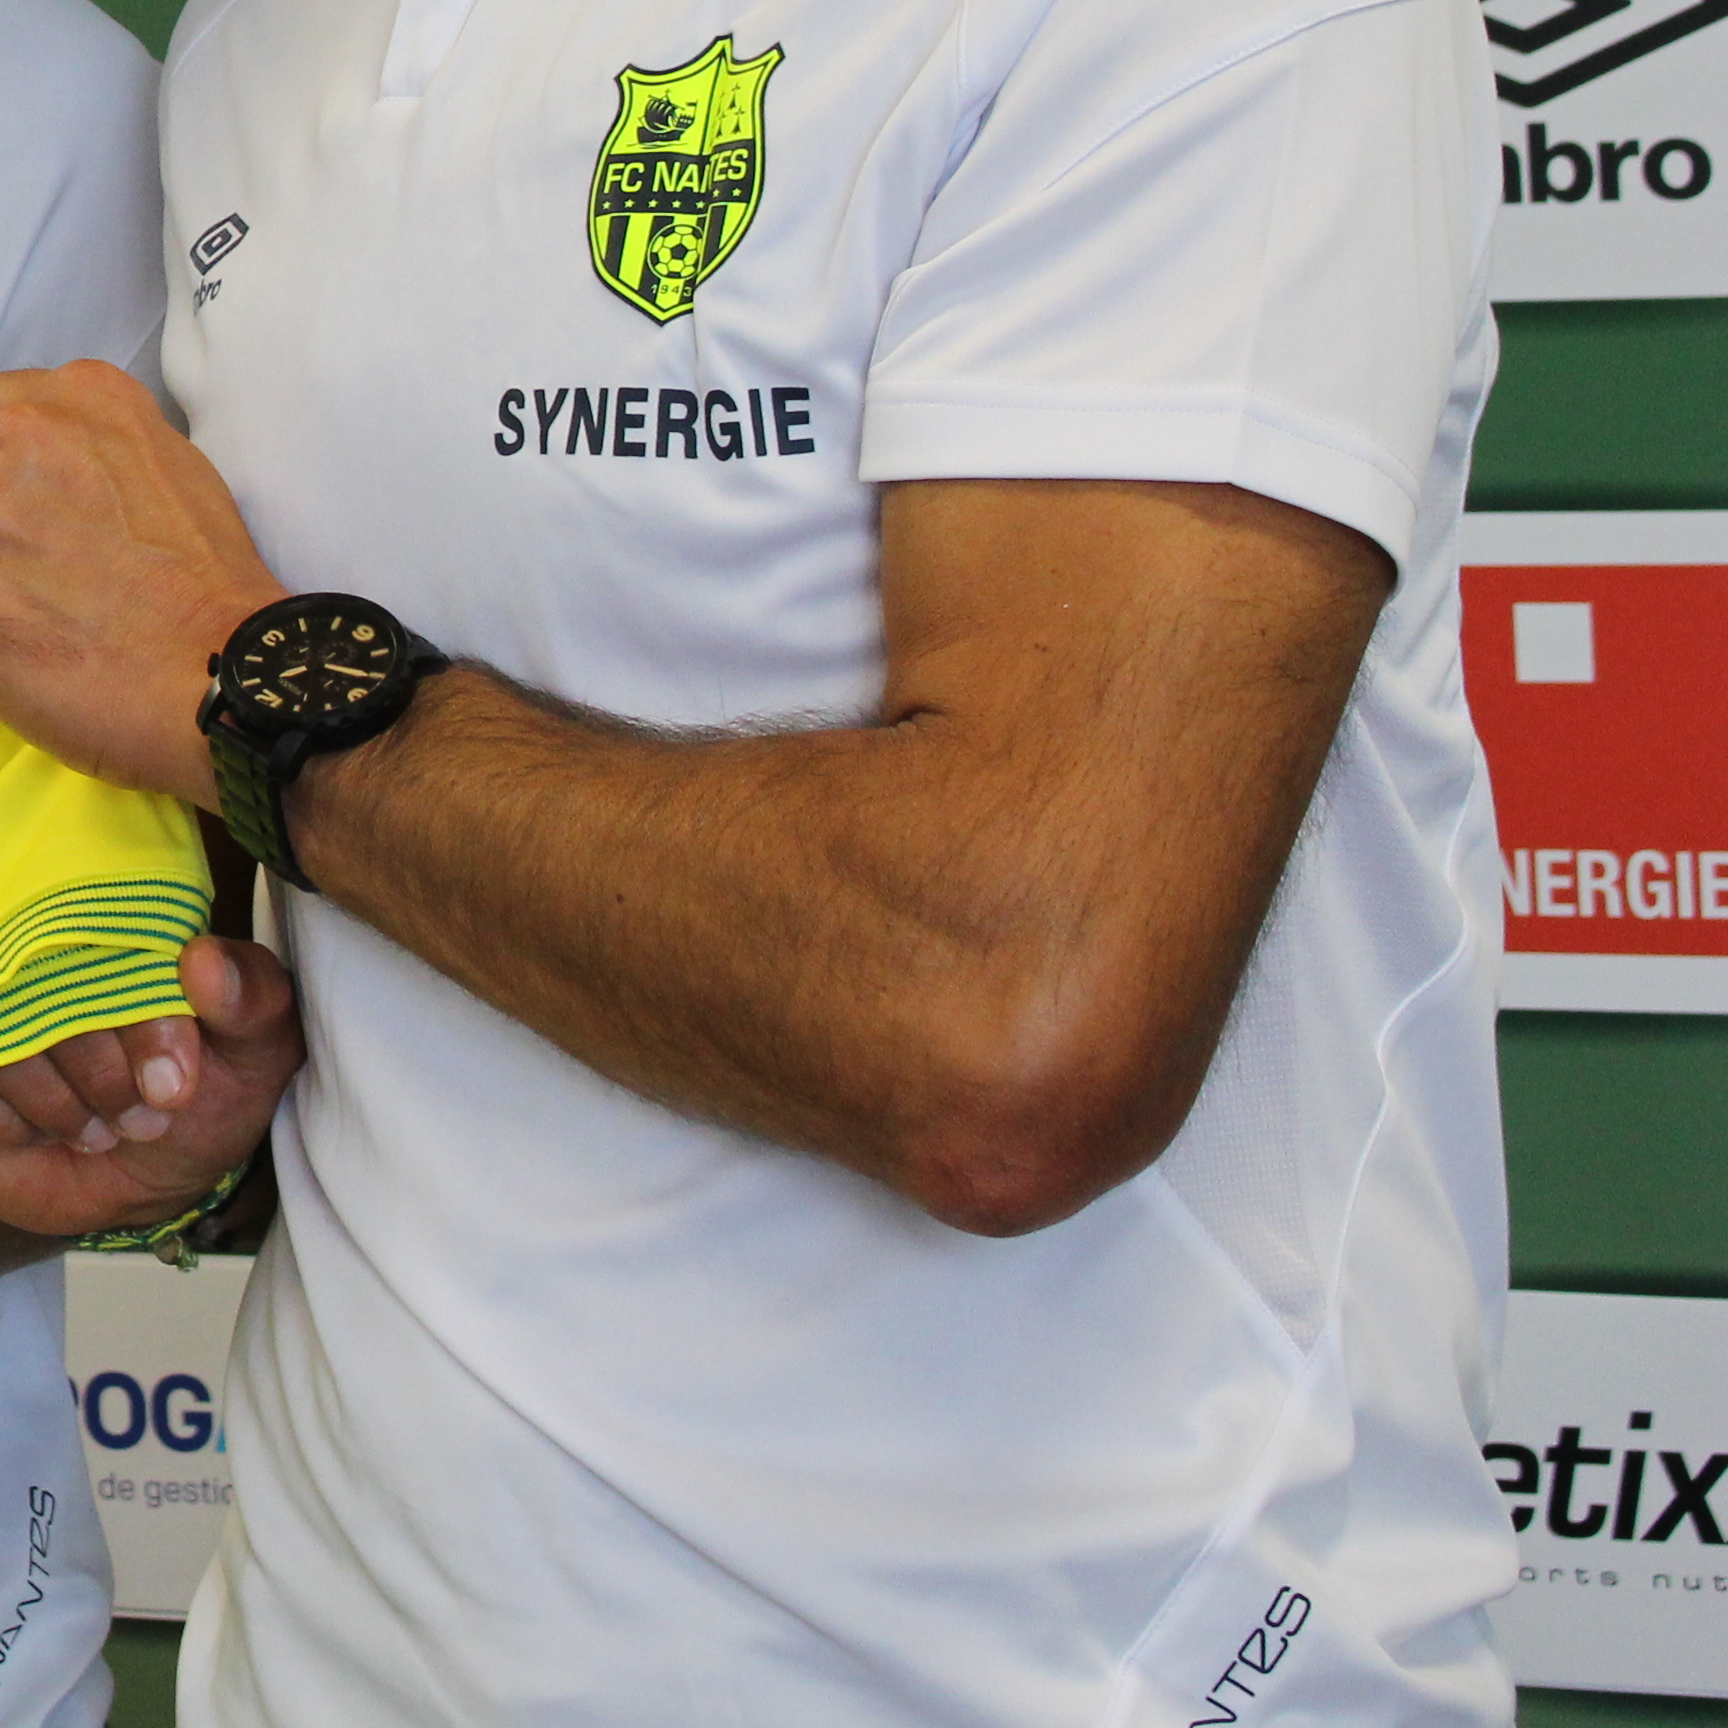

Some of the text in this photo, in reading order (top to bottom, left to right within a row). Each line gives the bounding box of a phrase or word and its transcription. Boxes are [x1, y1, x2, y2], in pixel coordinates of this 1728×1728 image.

[603, 161, 645, 194] FC
[651, 283, 693, 298] 1943
[492, 385, 816, 462] SYNERGIE
[98, 1472, 135, 1500] de
[1482, 1410, 1728, 1545] etix
